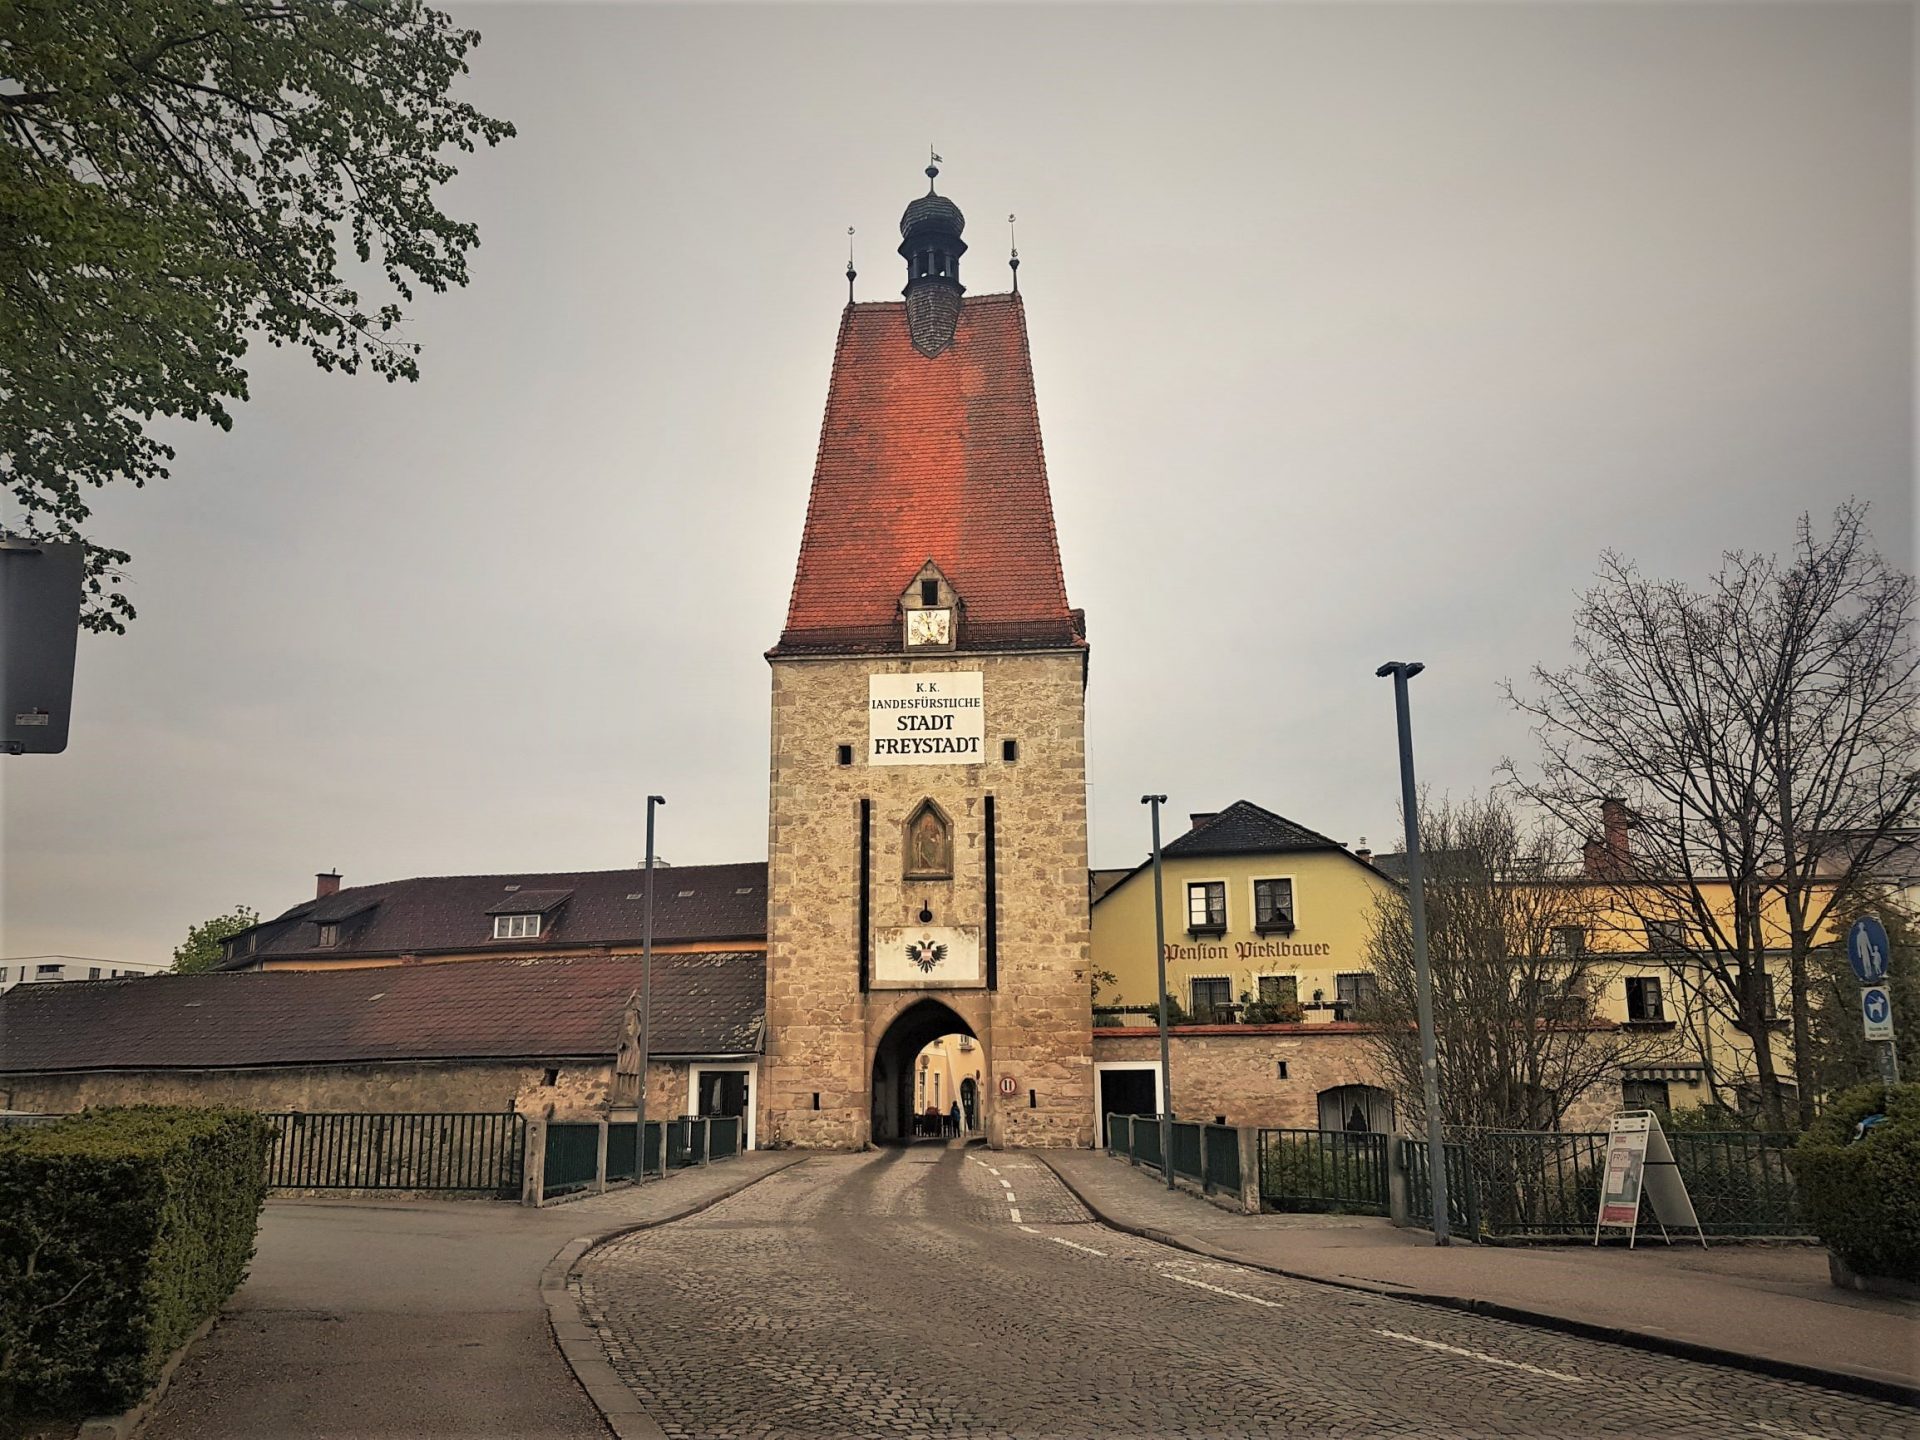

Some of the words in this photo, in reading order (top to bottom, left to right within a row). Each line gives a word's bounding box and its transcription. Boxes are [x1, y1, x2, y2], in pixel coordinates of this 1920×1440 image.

[897, 715, 954, 731] STADT
[874, 737, 980, 755] FREYSTADT
[1235, 941, 1330, 961] Pirklbauer
